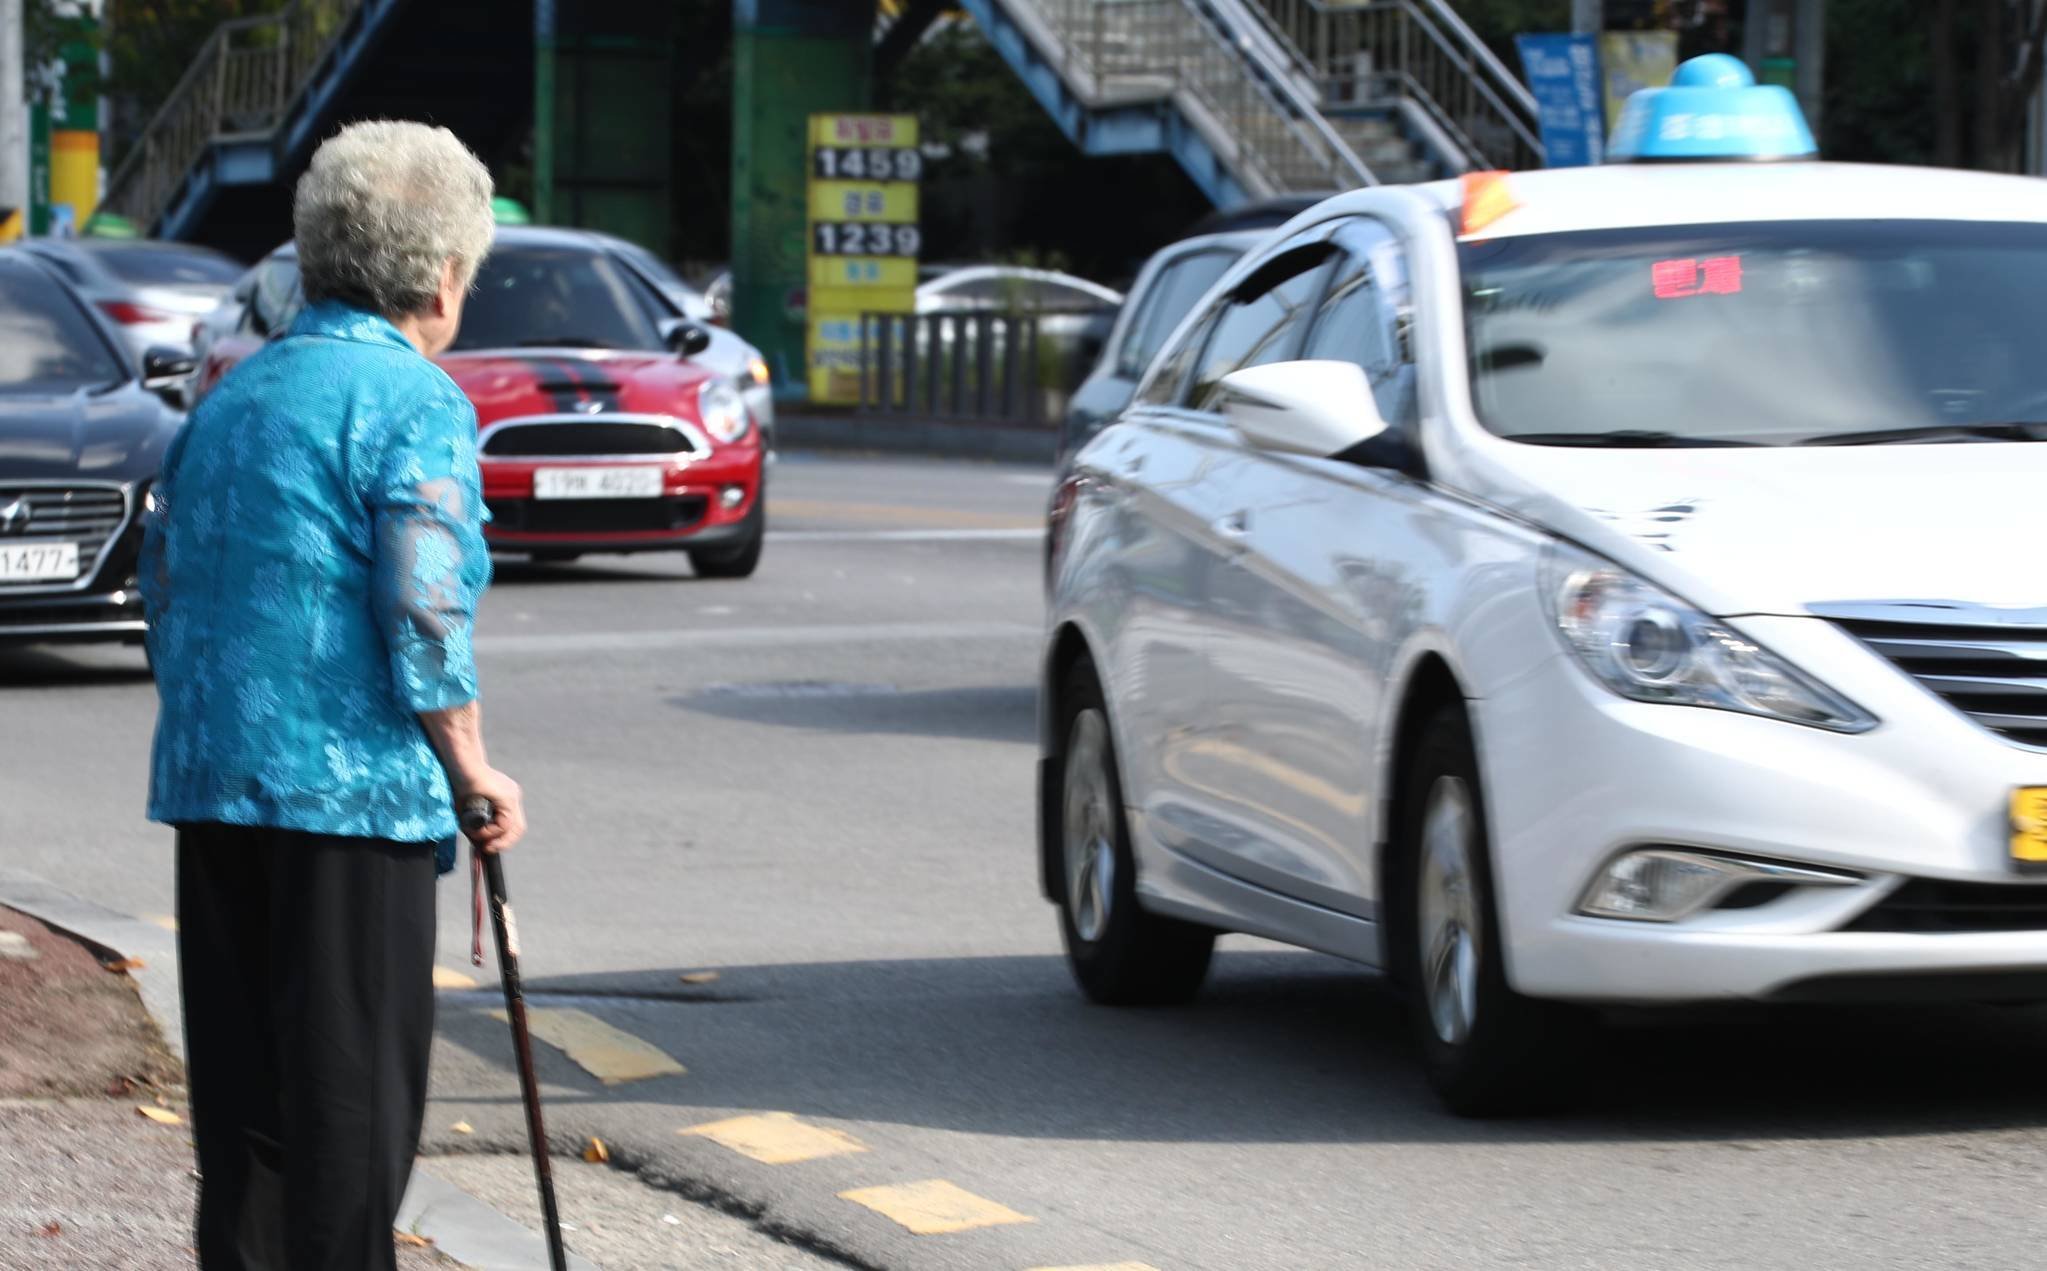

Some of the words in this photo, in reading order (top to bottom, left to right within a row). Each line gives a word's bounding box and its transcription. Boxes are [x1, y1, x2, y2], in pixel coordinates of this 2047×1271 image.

[818, 147, 921, 178] 1459
[818, 224, 920, 256] 1239
[1, 549, 63, 573] 1477
